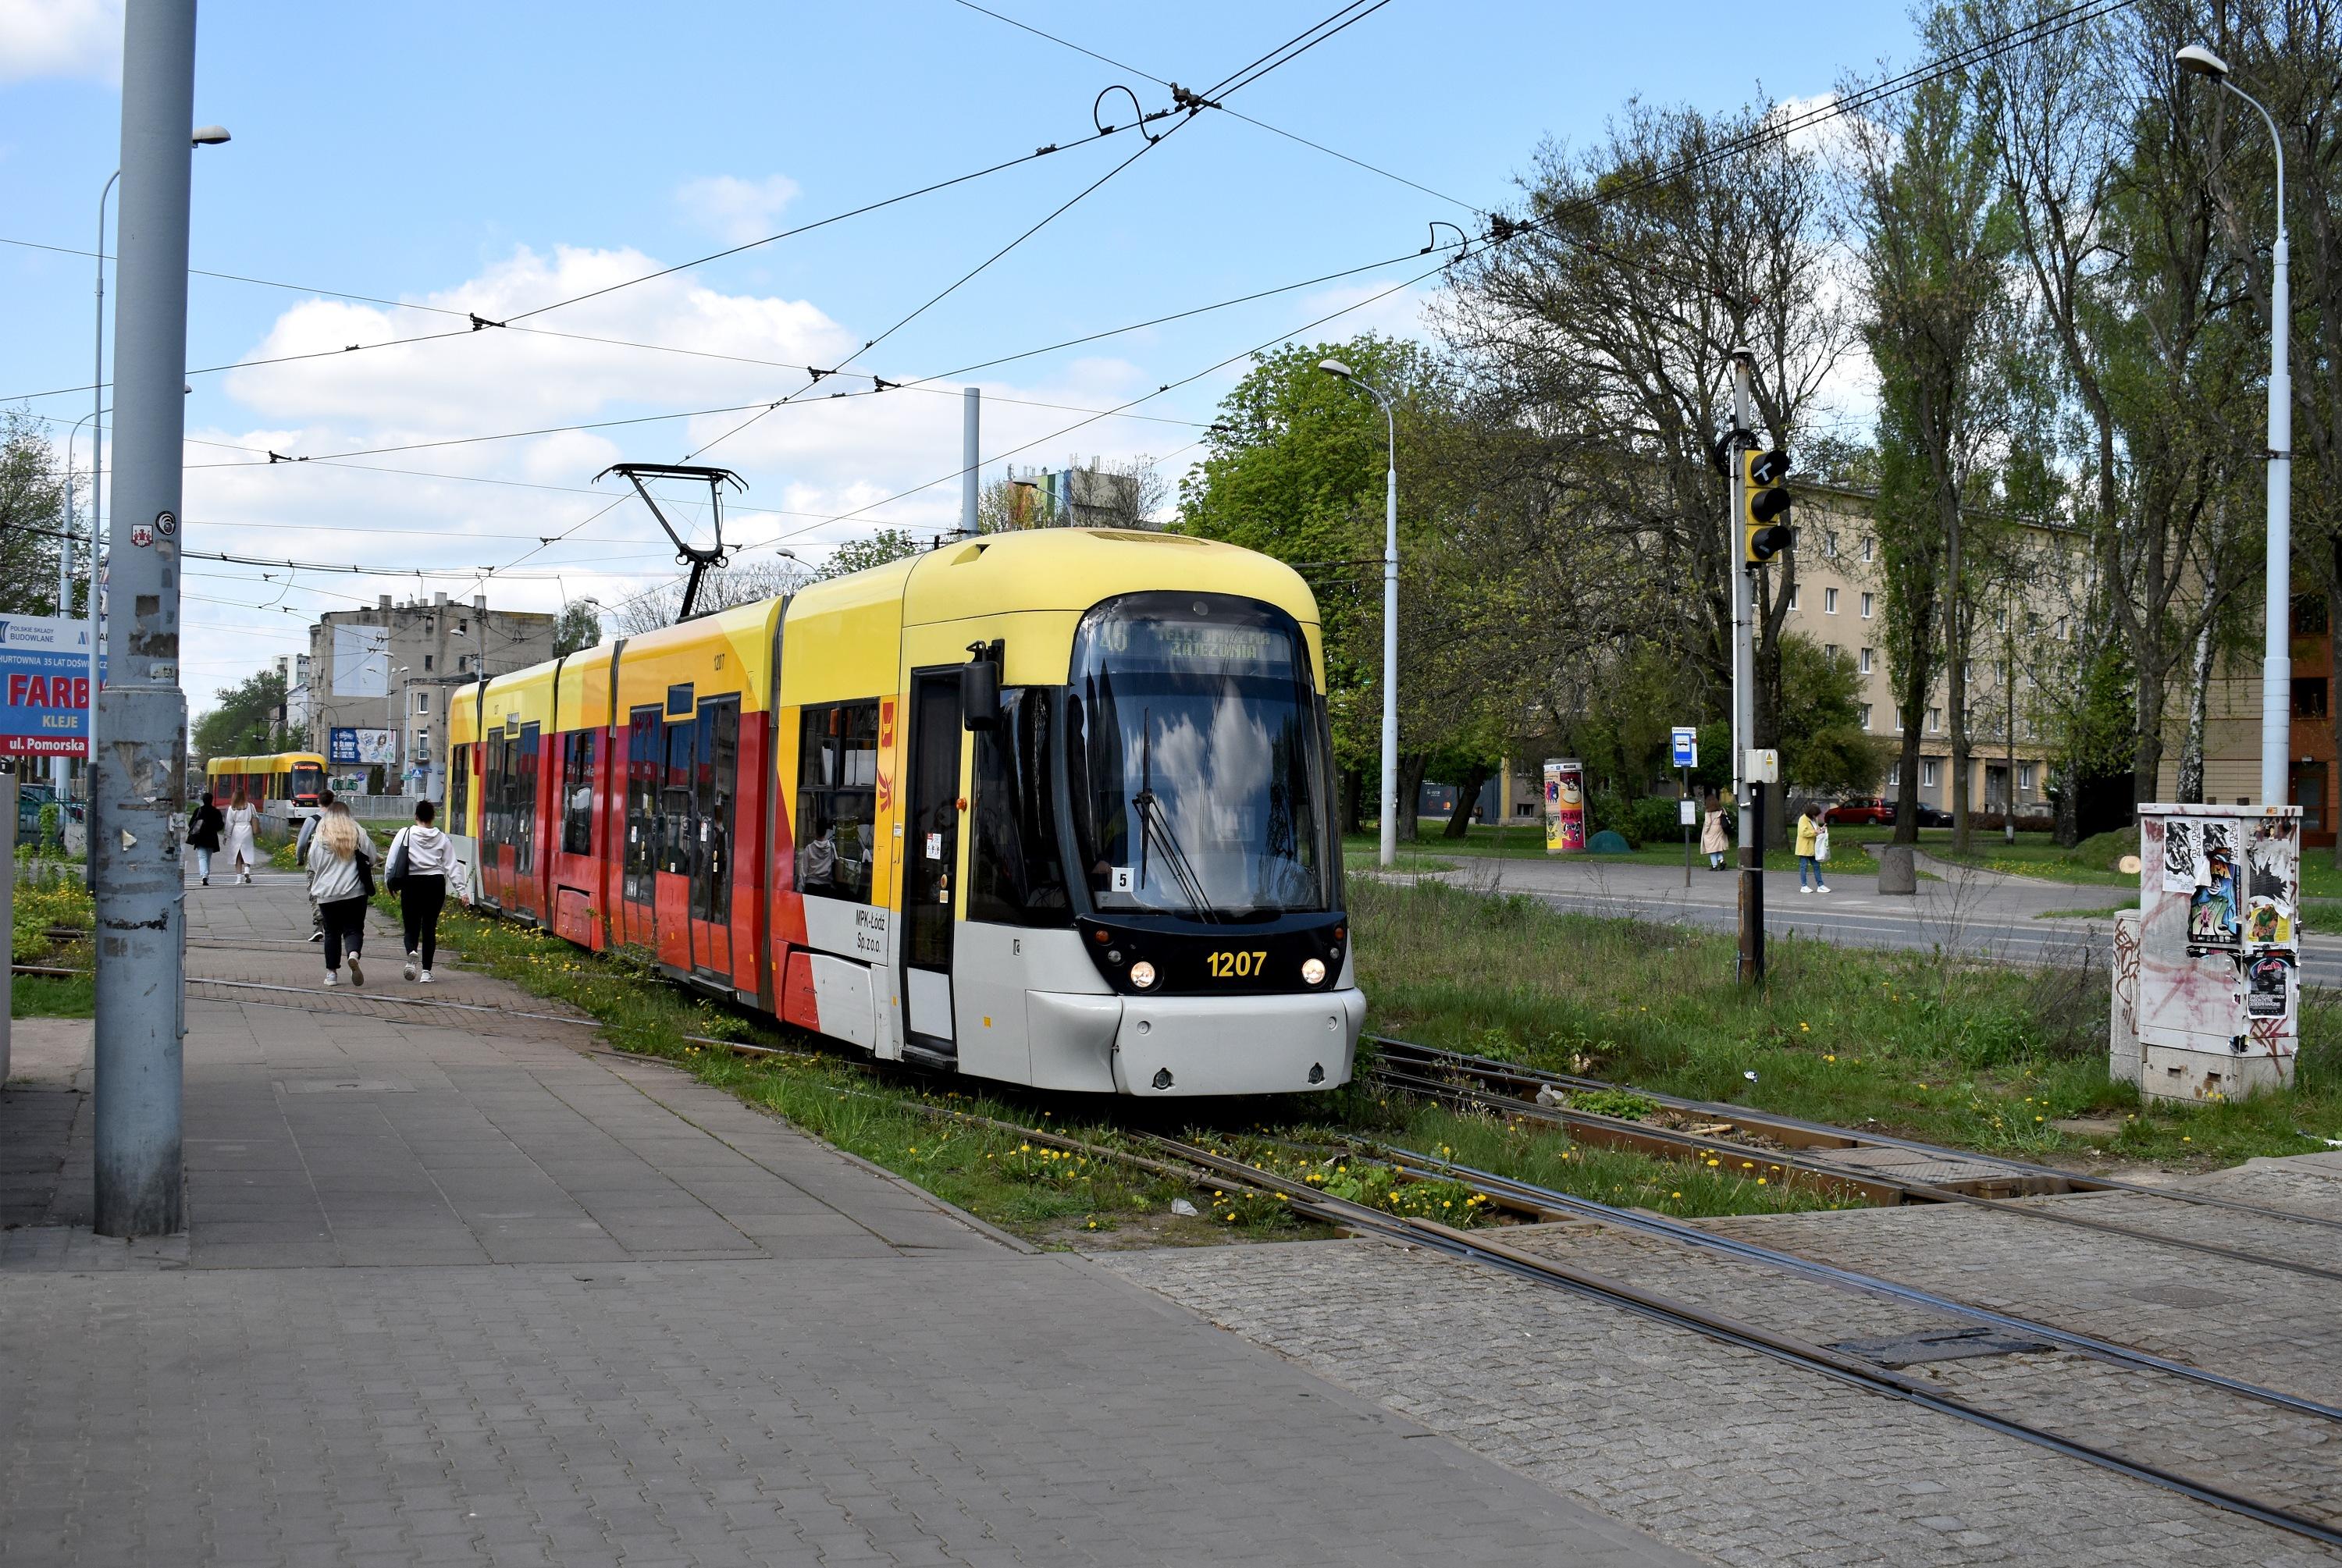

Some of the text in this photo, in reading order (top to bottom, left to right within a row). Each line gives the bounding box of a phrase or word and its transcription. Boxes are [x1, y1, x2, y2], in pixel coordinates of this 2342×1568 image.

[10, 633, 54, 642] BUDOWLANE
[714, 653, 725, 671] 1207
[8, 674, 107, 709] FARB
[42, 715, 78, 728] KLEJE
[9, 738, 85, 751] ul. Pomorska
[2191, 832, 2201, 841] 24
[2230, 833, 2238, 842] 24
[2233, 842, 2238, 851] 2
[2191, 849, 2201, 859] 24
[1119, 873, 1127, 887] 5
[856, 909, 885, 931] MPK-Łódź
[1207, 951, 1267, 976] 1207
